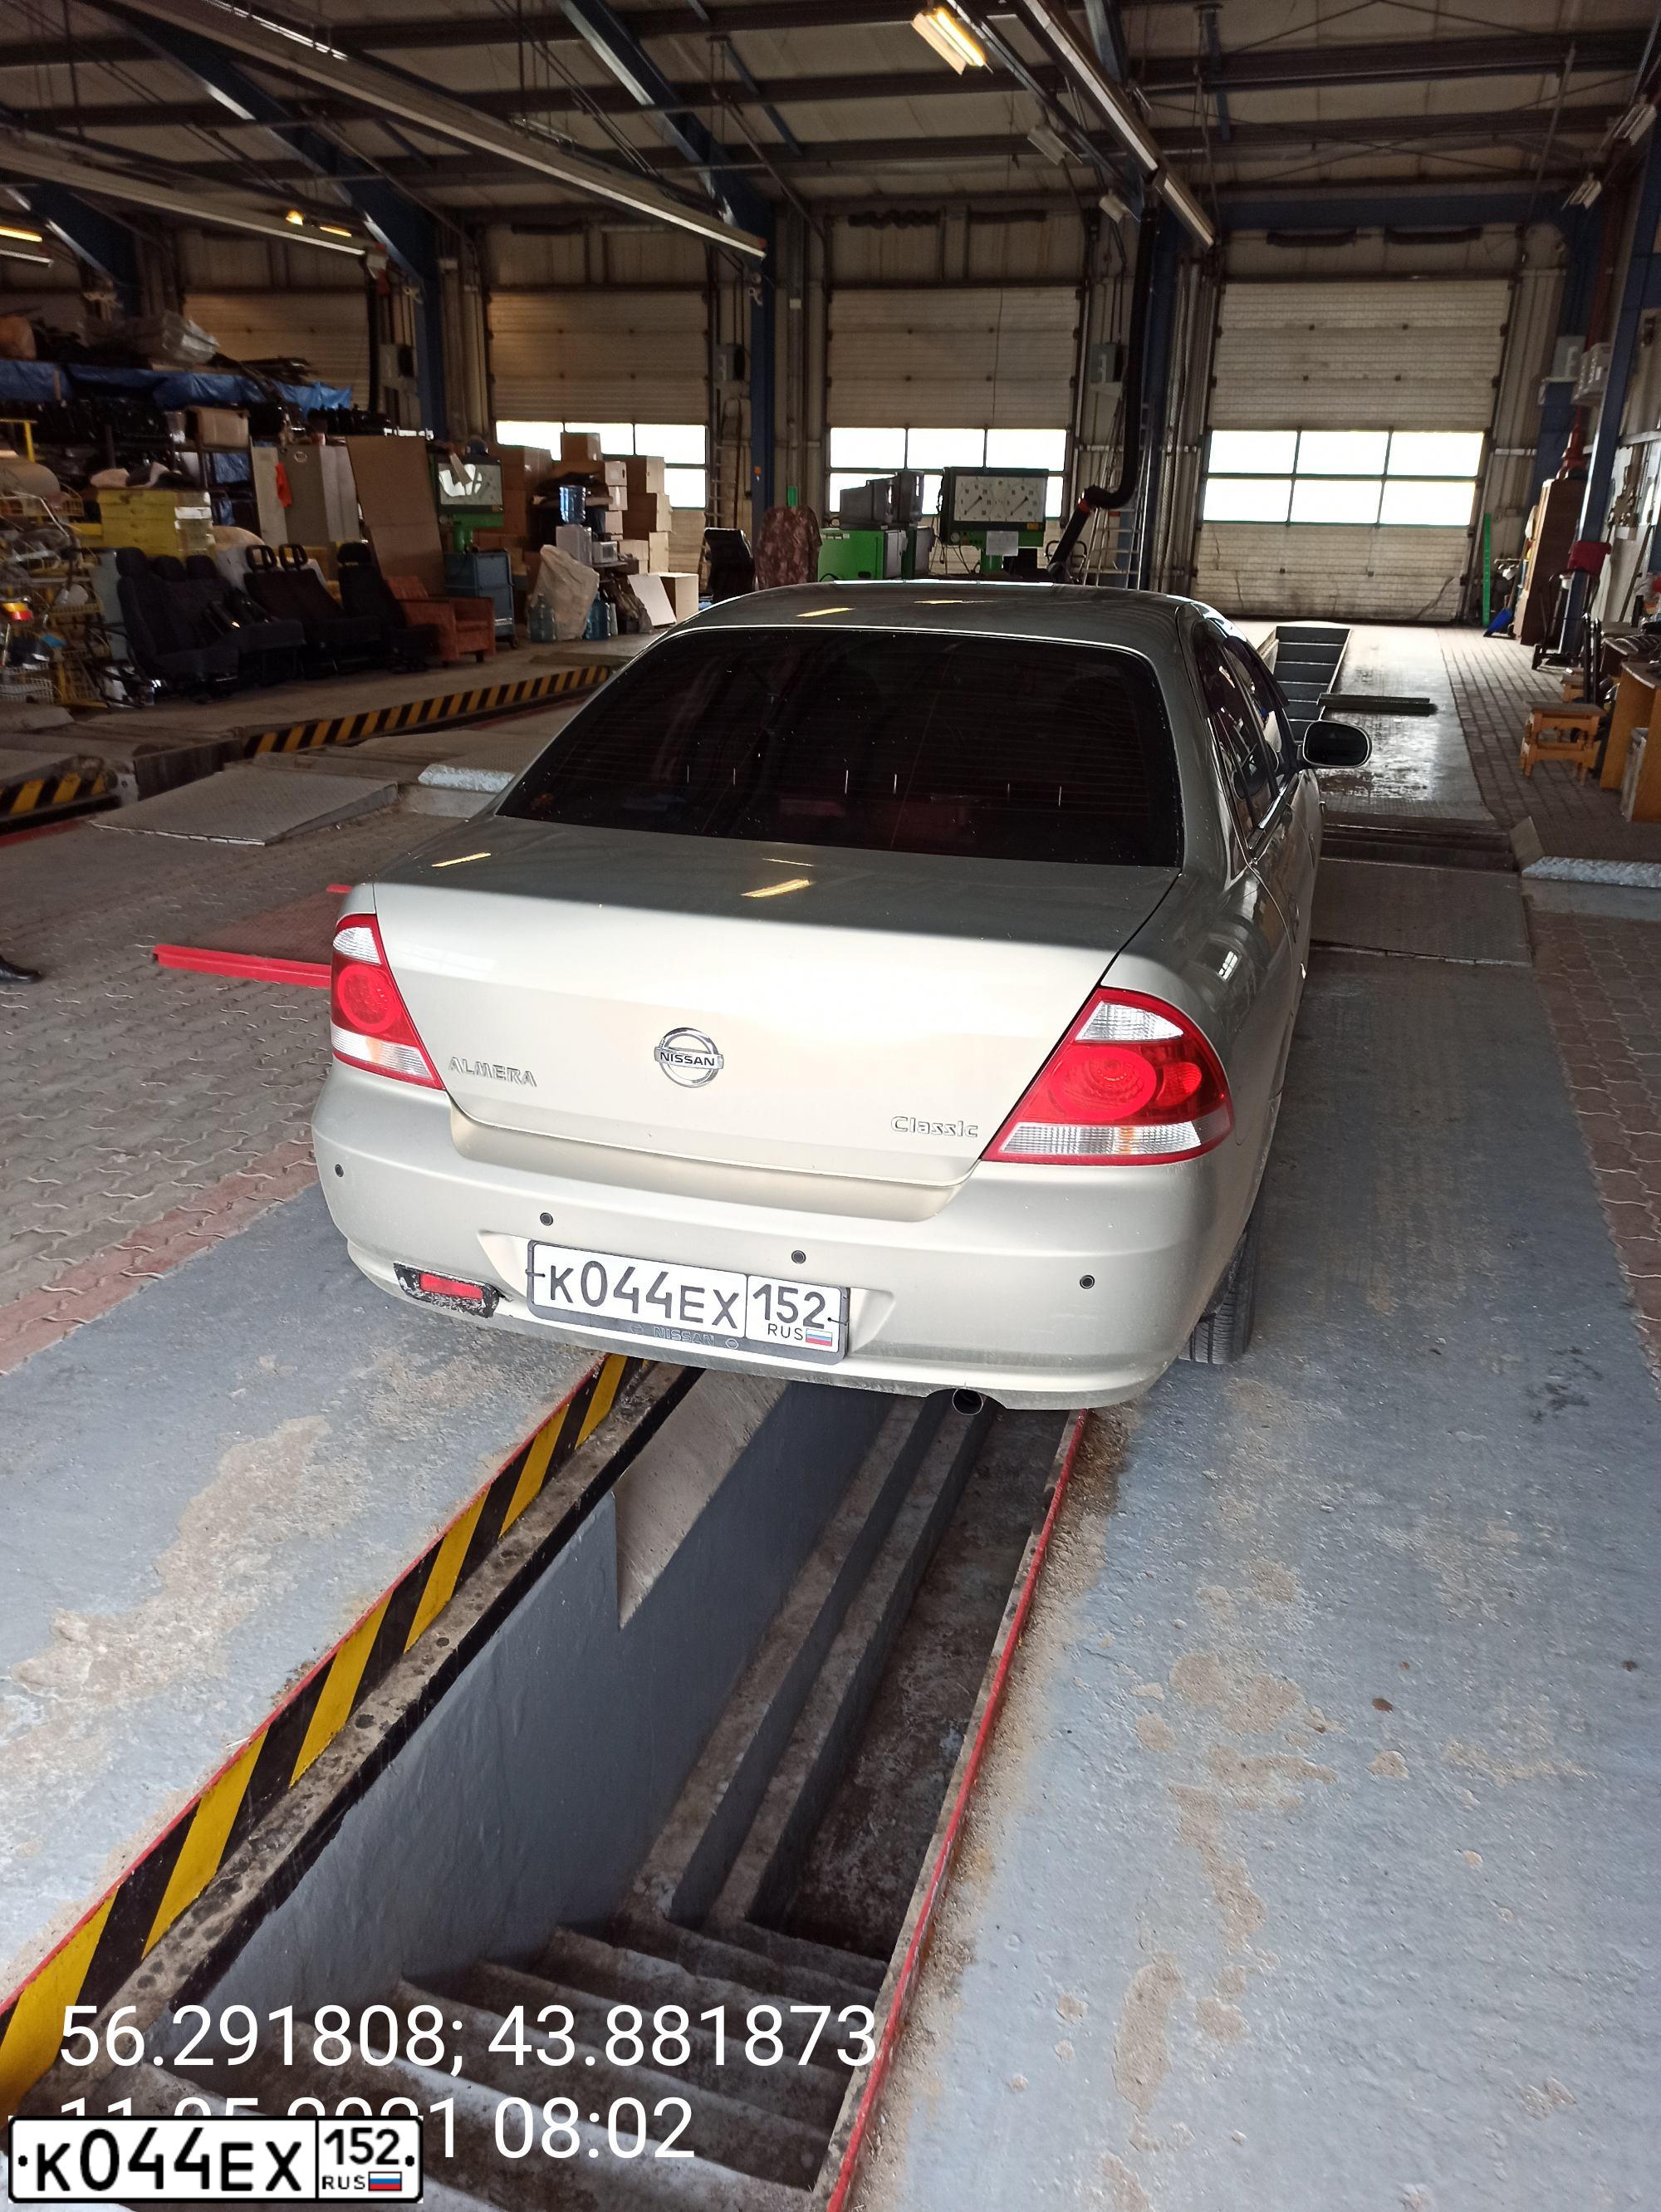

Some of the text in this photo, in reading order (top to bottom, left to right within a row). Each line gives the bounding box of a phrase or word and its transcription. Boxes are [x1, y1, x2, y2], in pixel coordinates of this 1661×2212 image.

[660, 1051, 715, 1067] NISSAN
[449, 1057, 537, 1087] ALMERA
[890, 1116, 978, 1137] Classic
[752, 1283, 826, 1329] 152
[654, 1327, 715, 1346] NISSAN
[767, 1323, 804, 1341] RUS
